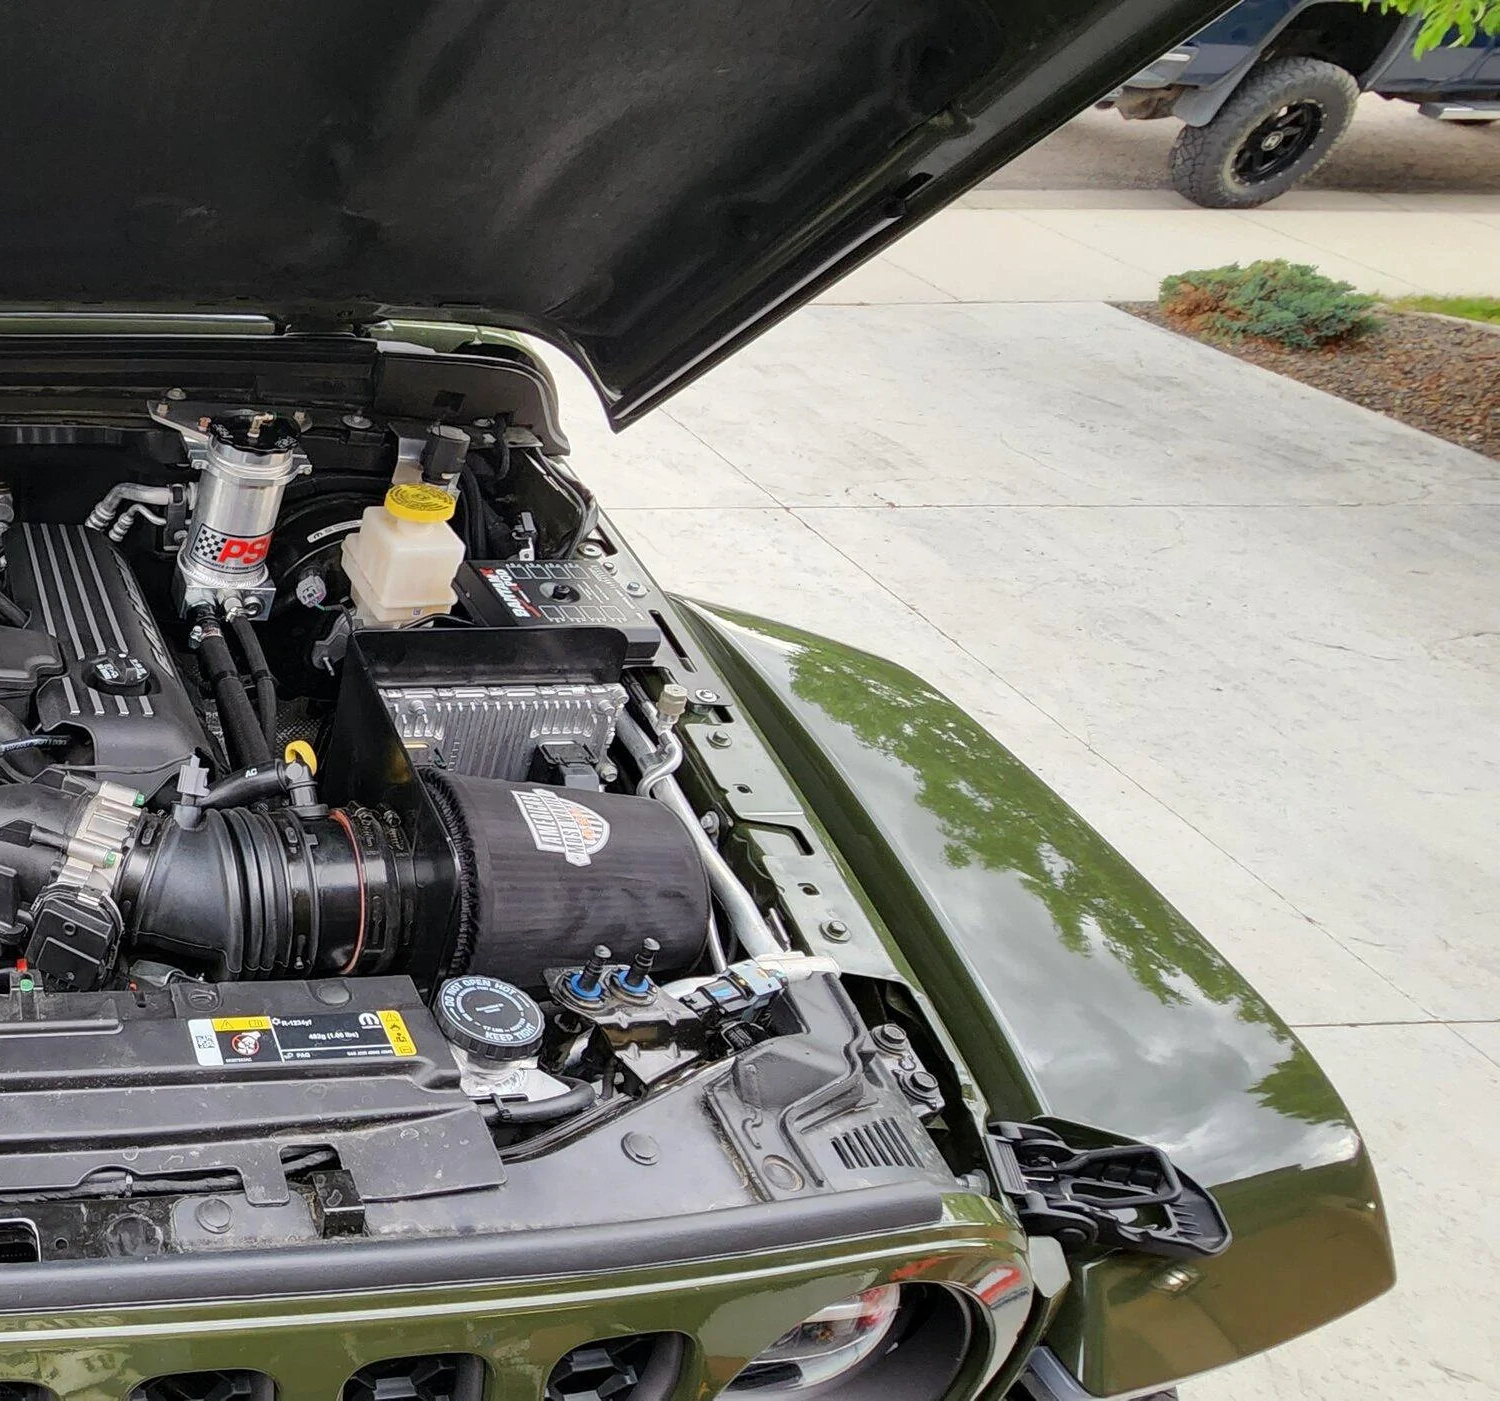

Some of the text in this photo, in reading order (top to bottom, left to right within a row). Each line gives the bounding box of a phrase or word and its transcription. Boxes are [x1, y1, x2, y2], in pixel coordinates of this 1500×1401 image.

[216, 537, 271, 565] PS
[446, 982, 463, 996] NOT
[462, 979, 492, 987] OPEN
[494, 982, 517, 995] HOT
[444, 995, 455, 1007] DO
[485, 1031, 514, 1042] KEEP
[513, 1022, 537, 1040] TIGHT
